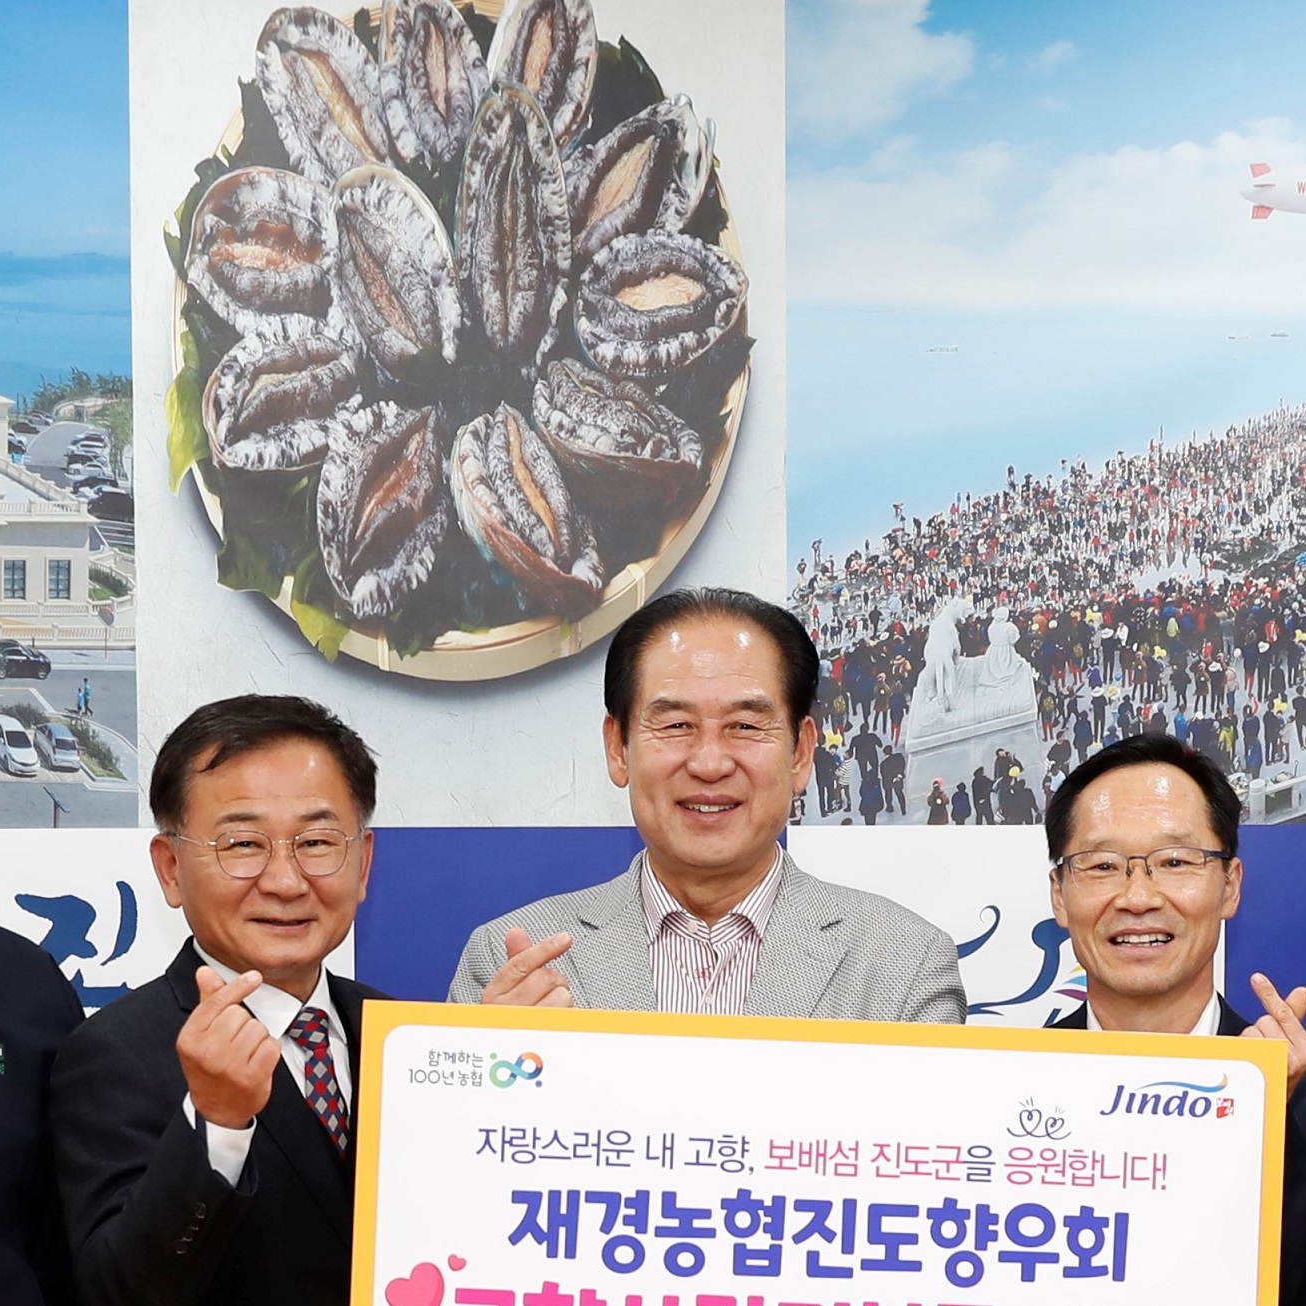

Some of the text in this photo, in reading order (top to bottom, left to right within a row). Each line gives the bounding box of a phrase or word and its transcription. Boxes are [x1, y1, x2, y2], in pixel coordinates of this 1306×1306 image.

[428, 1049, 484, 1069] 함께하는
[408, 1068, 483, 1087] 100년 농협
[1099, 1085, 1212, 1118] Jindo
[476, 1125, 1168, 1191] 자랑스러운 내 고향, 보배섬 진도군을 응원합니다!
[508, 1188, 1131, 1288] 재경농협진도향우회
